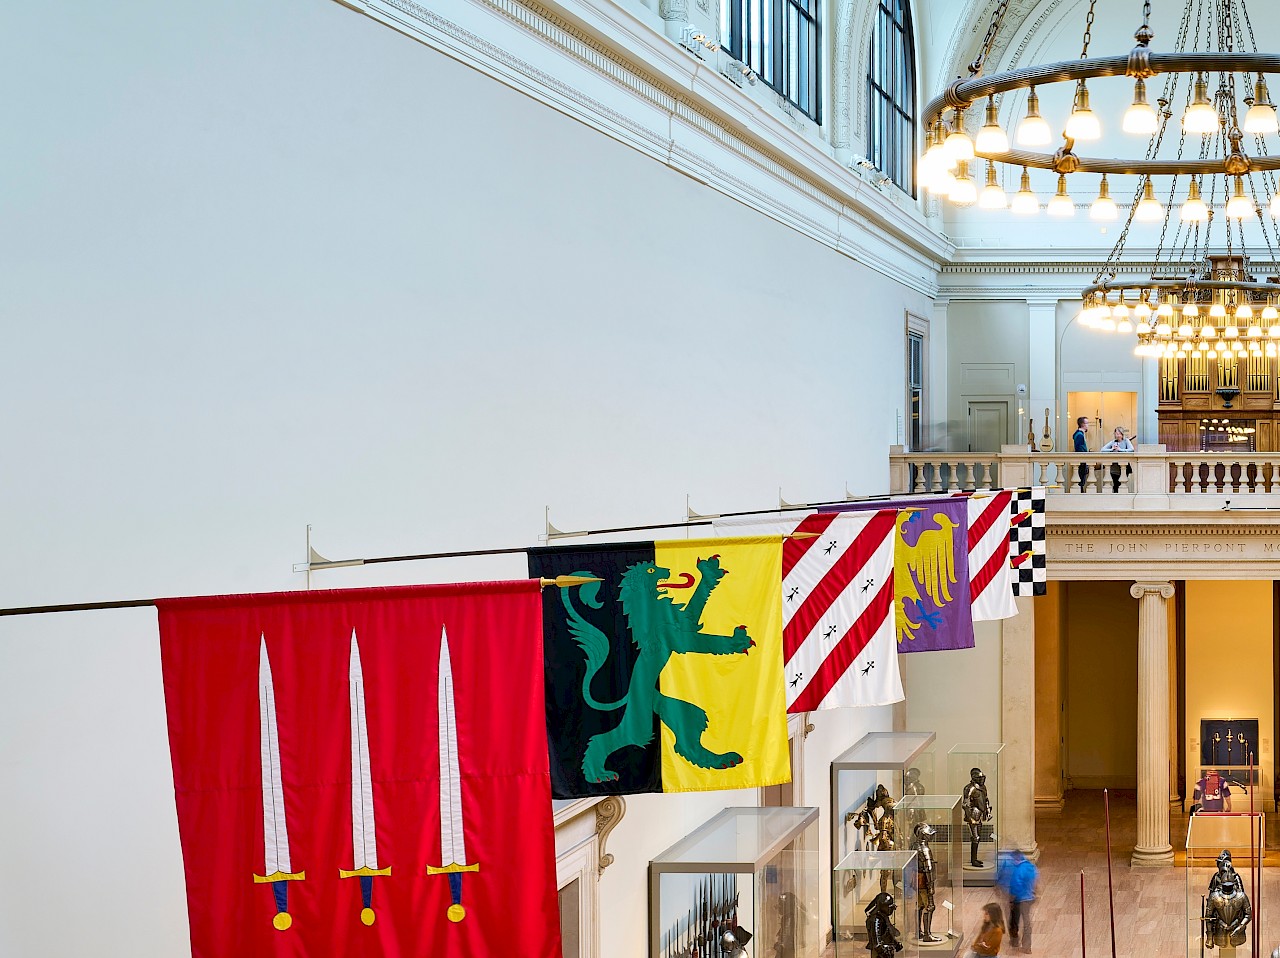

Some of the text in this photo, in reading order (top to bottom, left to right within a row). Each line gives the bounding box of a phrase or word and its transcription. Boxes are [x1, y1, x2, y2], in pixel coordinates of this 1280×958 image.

[1064, 543, 1094, 553] THE
[1109, 543, 1149, 554] JOHN
[1164, 543, 1247, 553] PIERPONT
